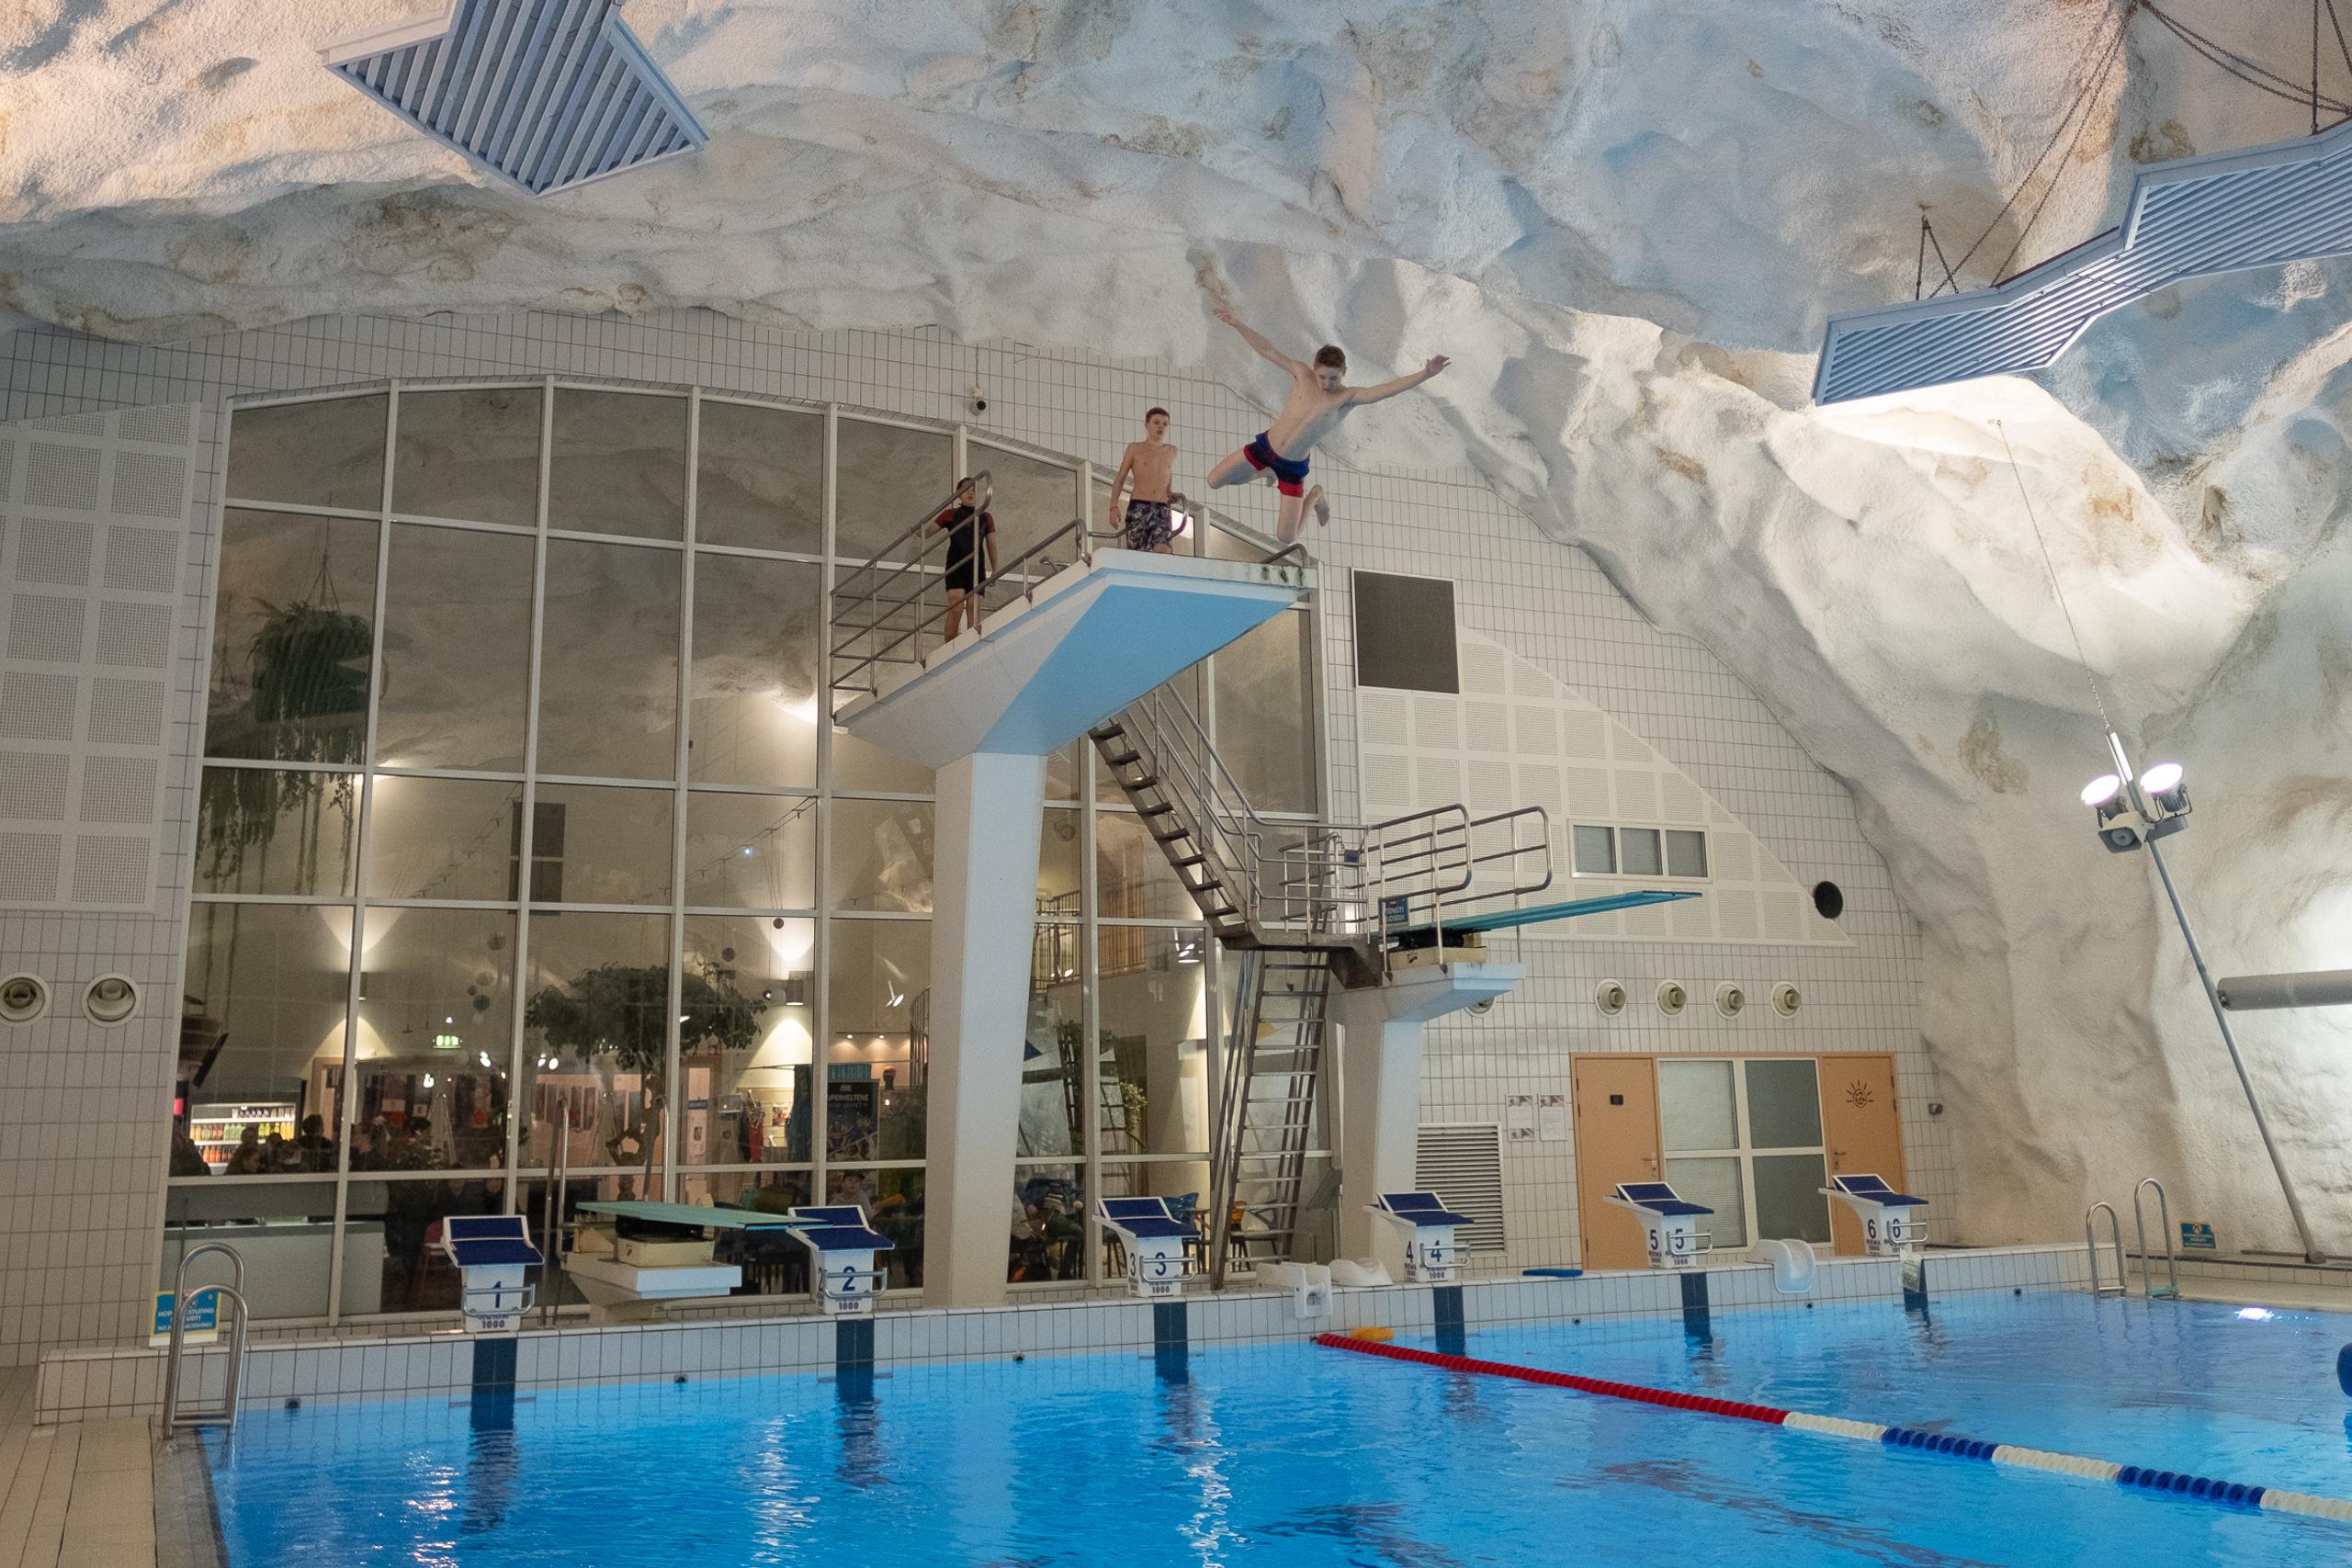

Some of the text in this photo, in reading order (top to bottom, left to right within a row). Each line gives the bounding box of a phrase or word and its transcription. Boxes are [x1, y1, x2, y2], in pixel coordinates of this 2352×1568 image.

[1385, 907, 1404, 915] TENGT!
[1675, 1228, 1684, 1249] 5
[1868, 1219, 1876, 1239] 6
[1893, 1218, 1901, 1238] 6
[1650, 1229, 1658, 1250] 5
[1406, 1240, 1414, 1264] 4
[1430, 1240, 1442, 1263] 4
[1130, 1253, 1136, 1277] 3
[1155, 1252, 1167, 1276] 3
[842, 1266, 855, 1292] 2
[492, 1280, 502, 1309] 1
[839, 1302, 859, 1310] 1000
[481, 1319, 505, 1329] 1000
